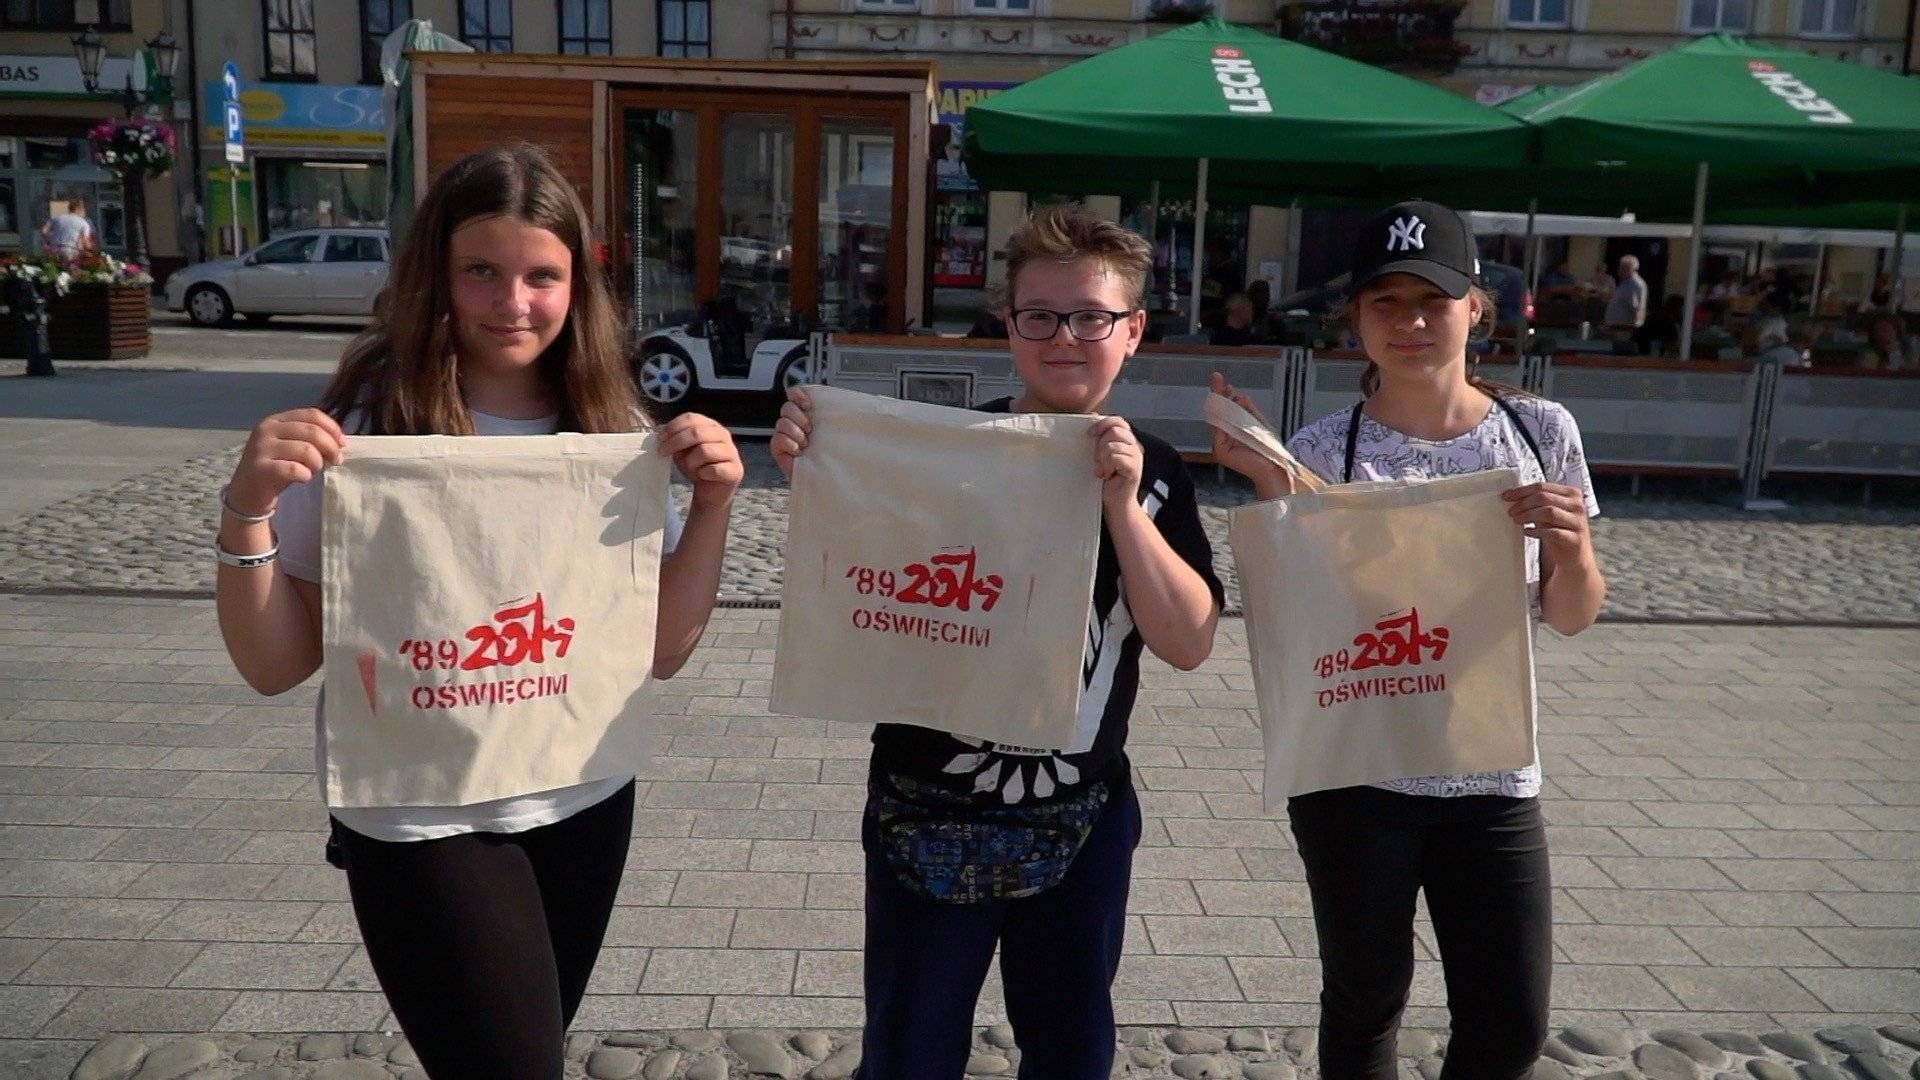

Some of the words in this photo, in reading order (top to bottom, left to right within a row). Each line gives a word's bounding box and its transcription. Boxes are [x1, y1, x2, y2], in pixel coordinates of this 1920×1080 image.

[0, 66, 40, 81] BAS
[1211, 58, 1273, 112] LECH
[1751, 72, 1853, 124] LECH
[1387, 216, 1427, 251] NY
[852, 605, 991, 648] OŚWIĘCIM
[411, 673, 567, 709] OŚWIĘCIM
[1318, 674, 1446, 708] OŚWIĘCIM
